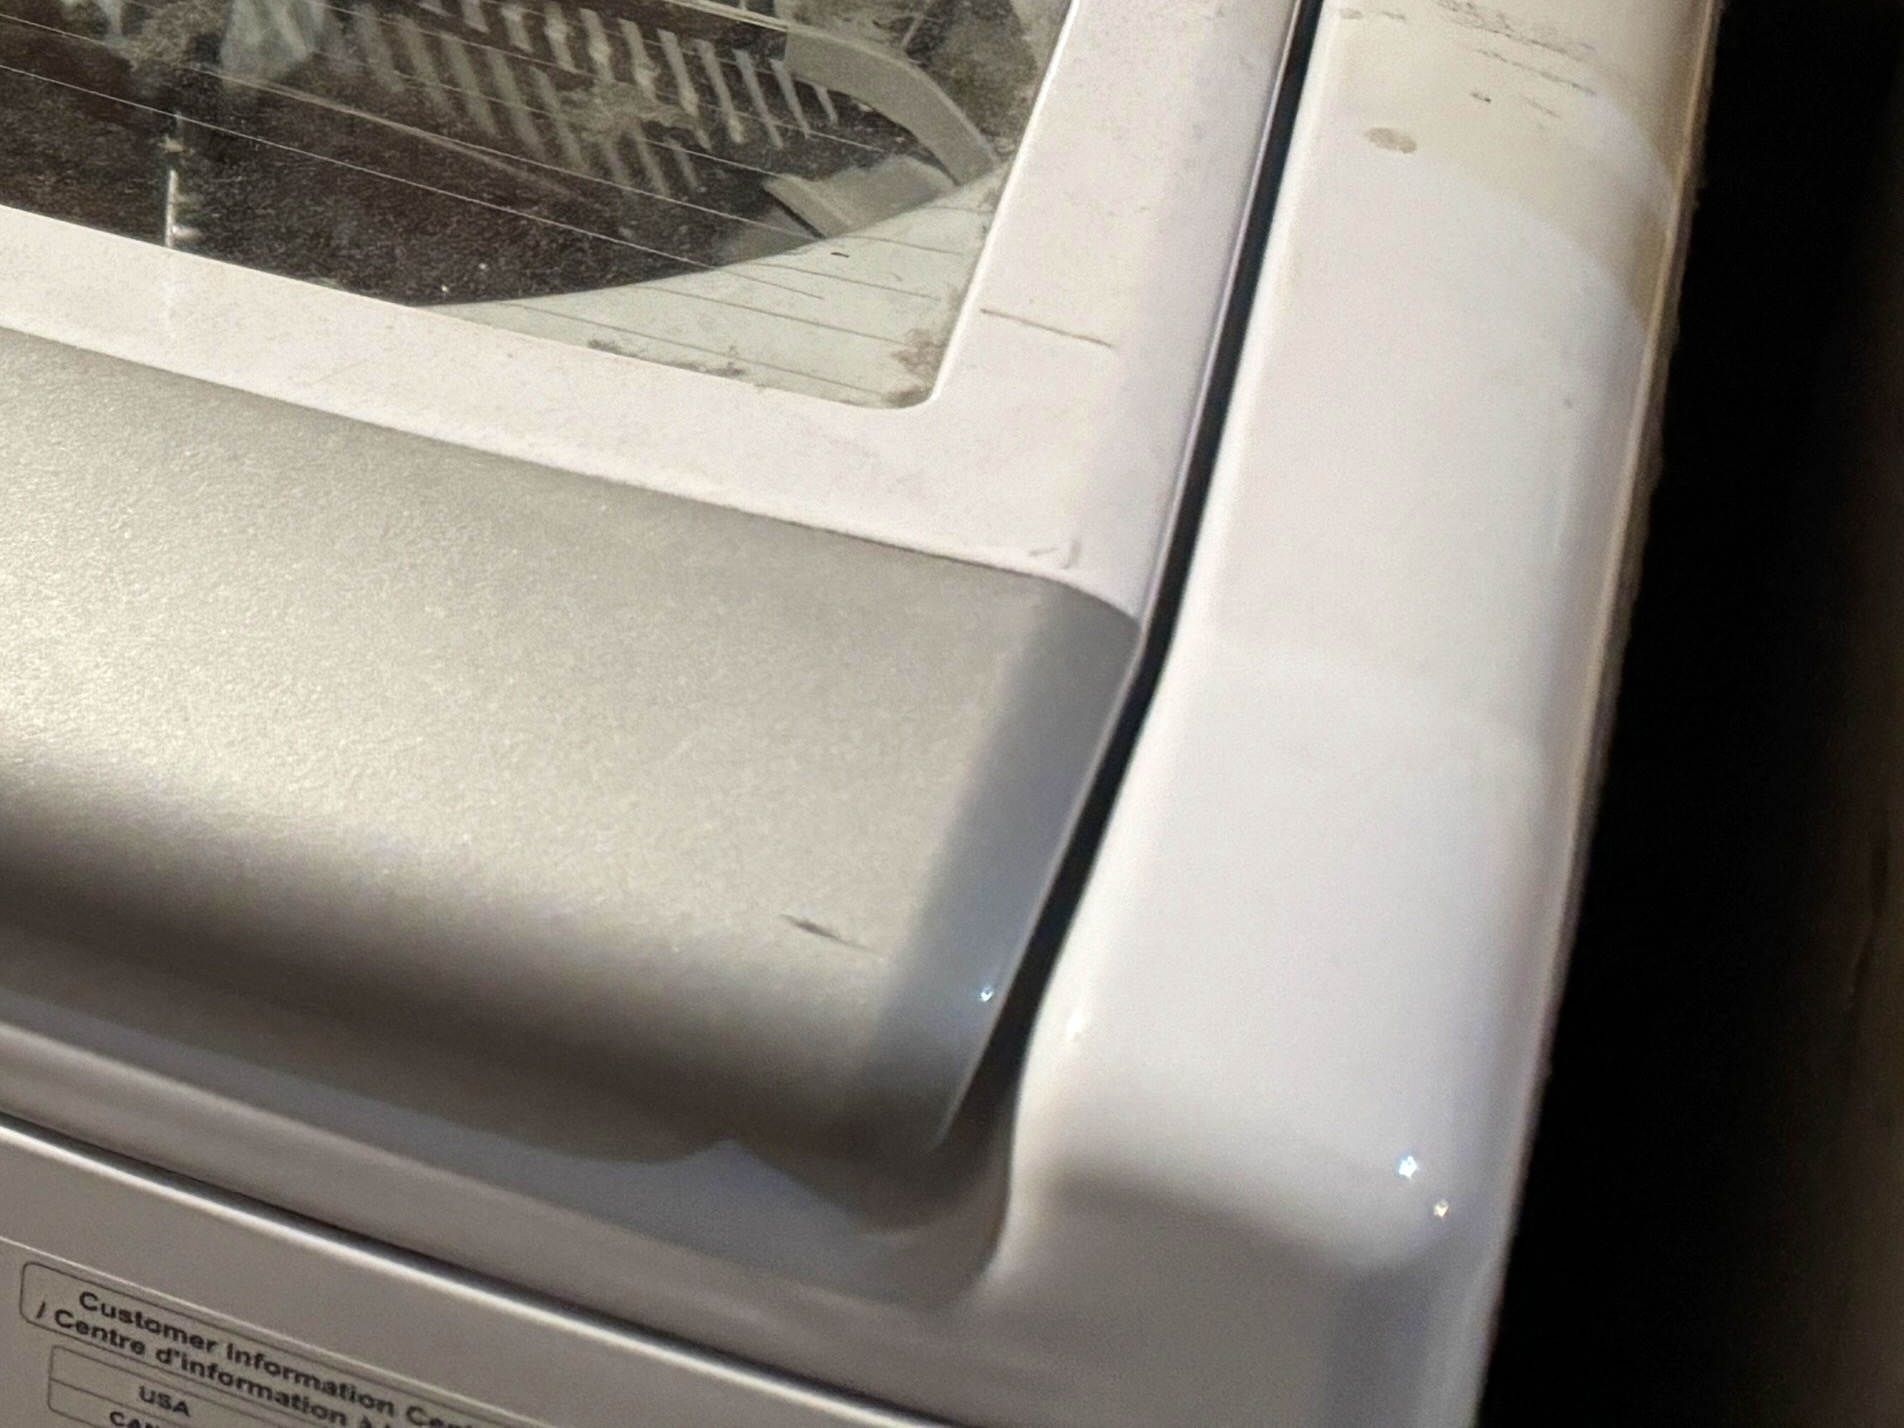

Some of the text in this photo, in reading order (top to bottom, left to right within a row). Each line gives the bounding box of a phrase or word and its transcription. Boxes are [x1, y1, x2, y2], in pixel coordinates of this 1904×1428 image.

[54, 1309, 146, 1355] Centre
[155, 1348, 348, 1428] d'information
[78, 1291, 473, 1428] Customer Information Ce
[139, 1385, 191, 1417] USA
